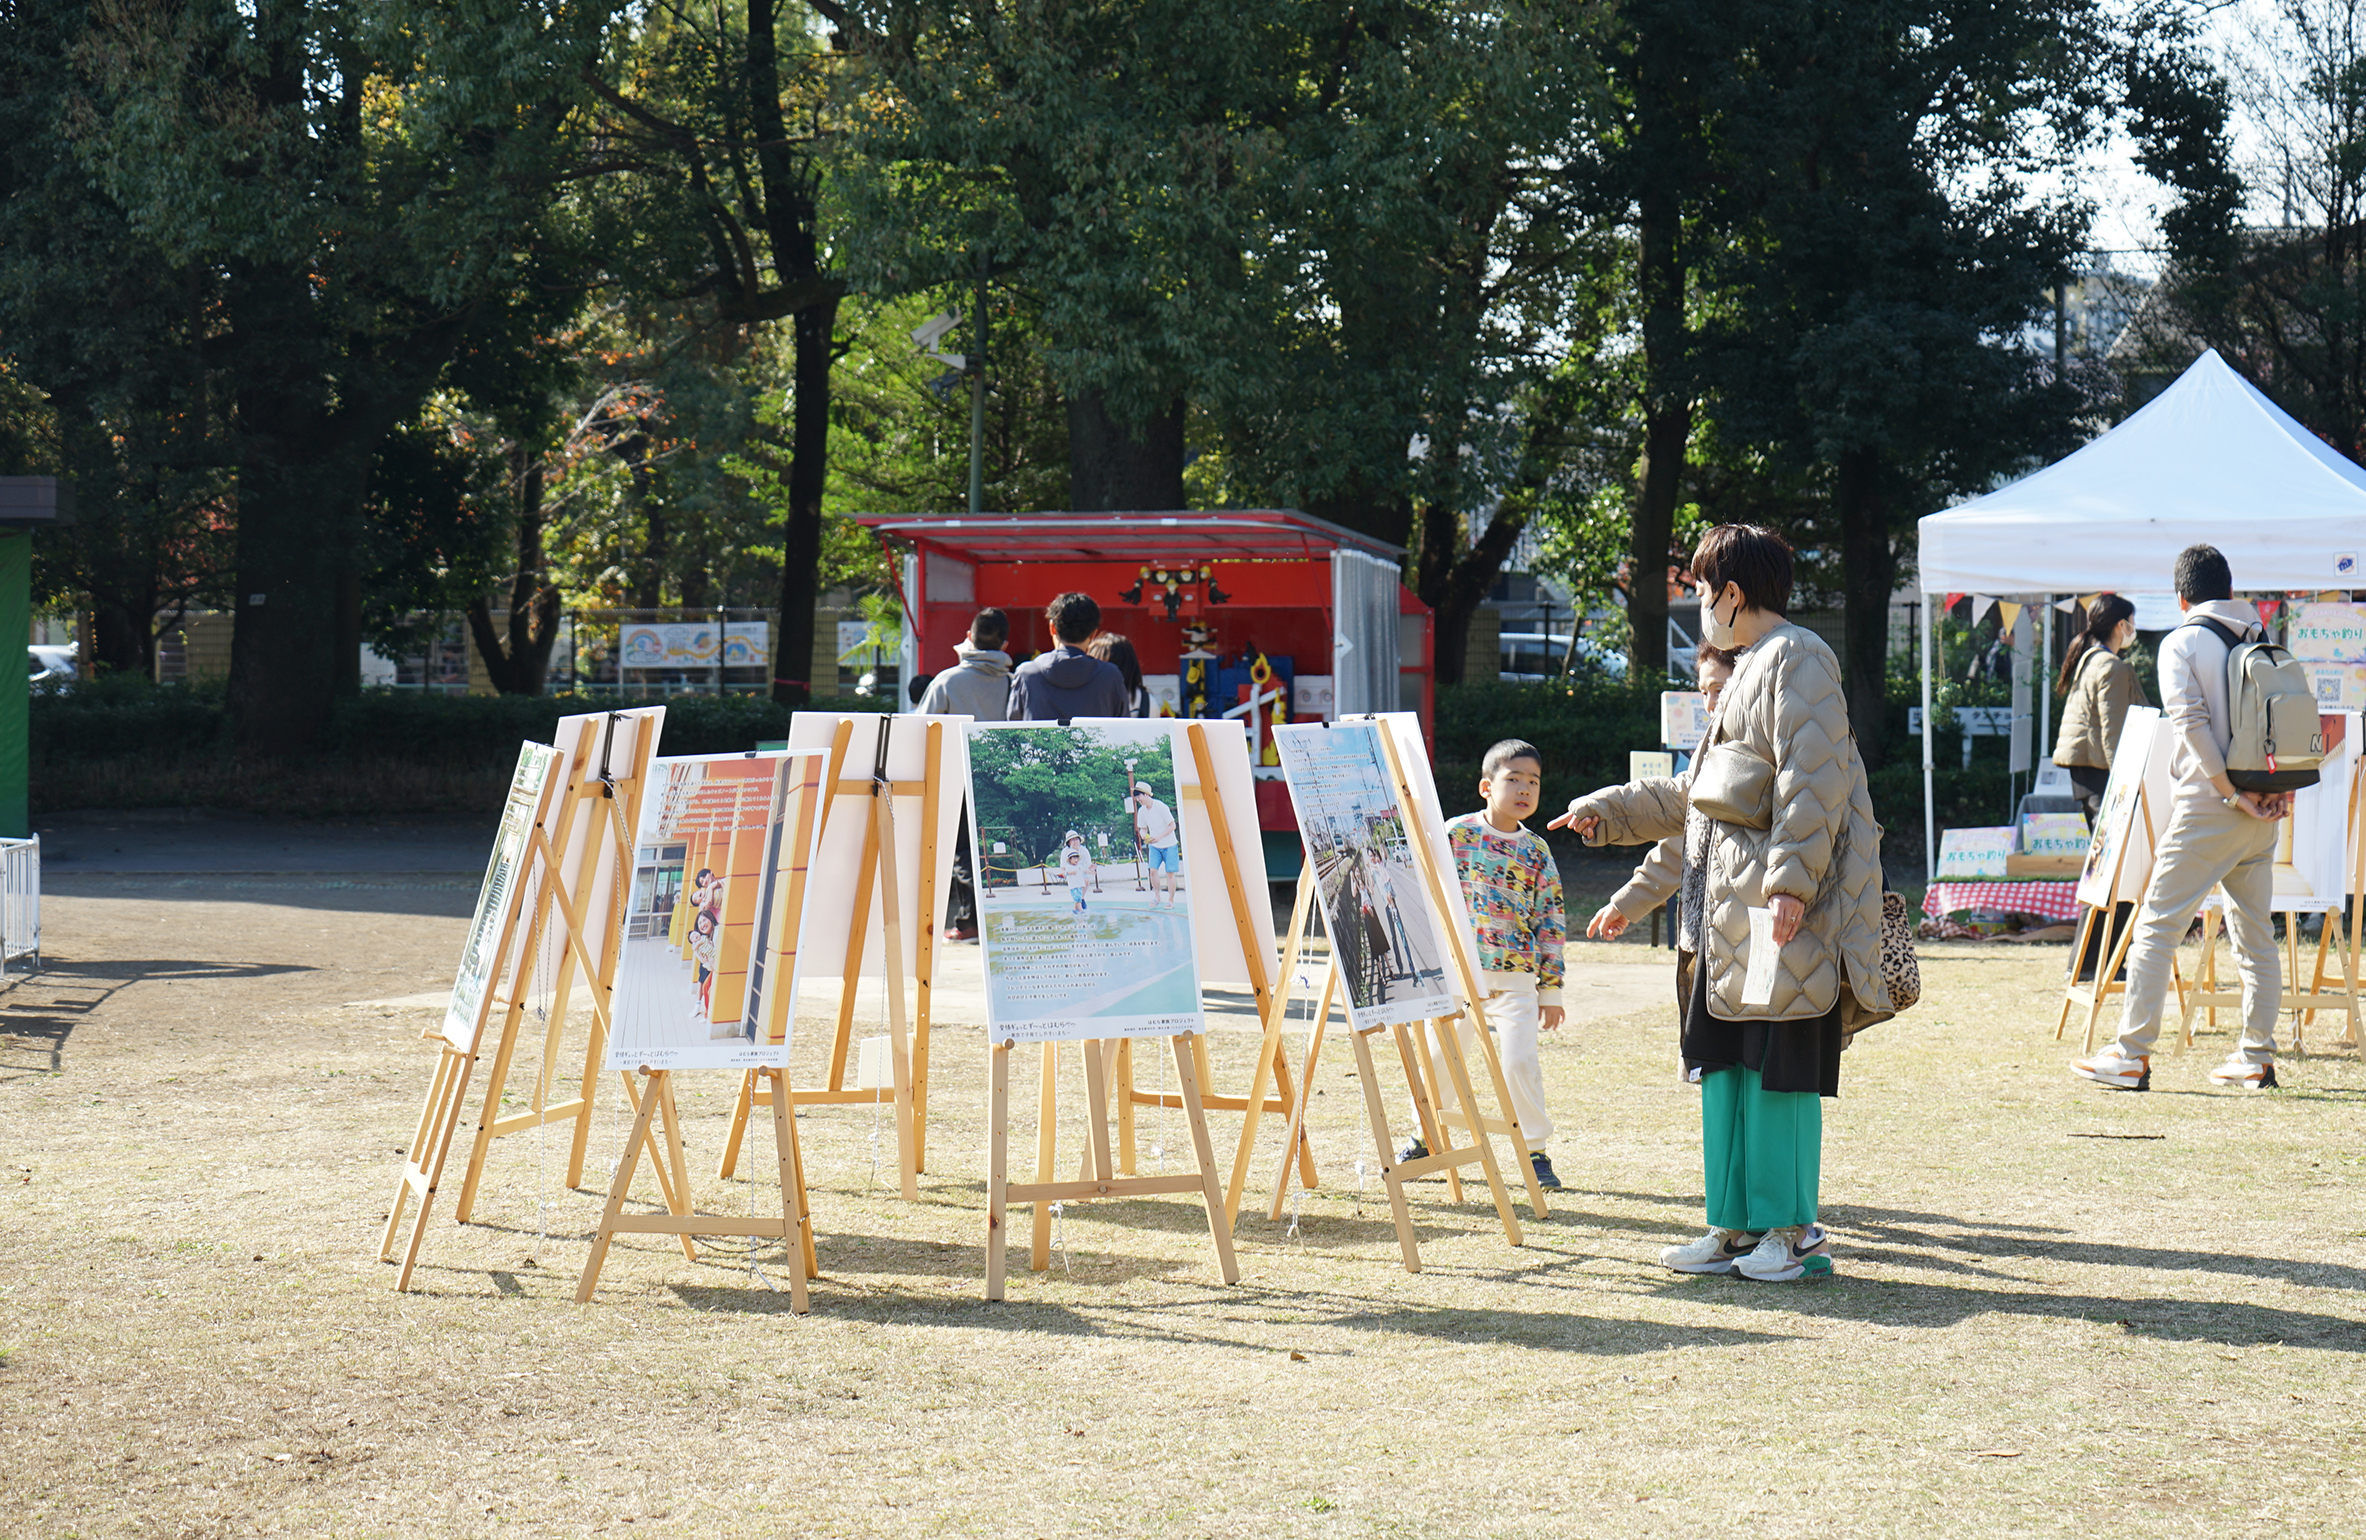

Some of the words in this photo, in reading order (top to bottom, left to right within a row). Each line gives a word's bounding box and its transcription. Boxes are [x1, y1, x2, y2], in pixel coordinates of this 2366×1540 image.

[2298, 627, 2363, 639] おもちゃ釣り
[1946, 849, 2006, 862] おもちゃ釣り
